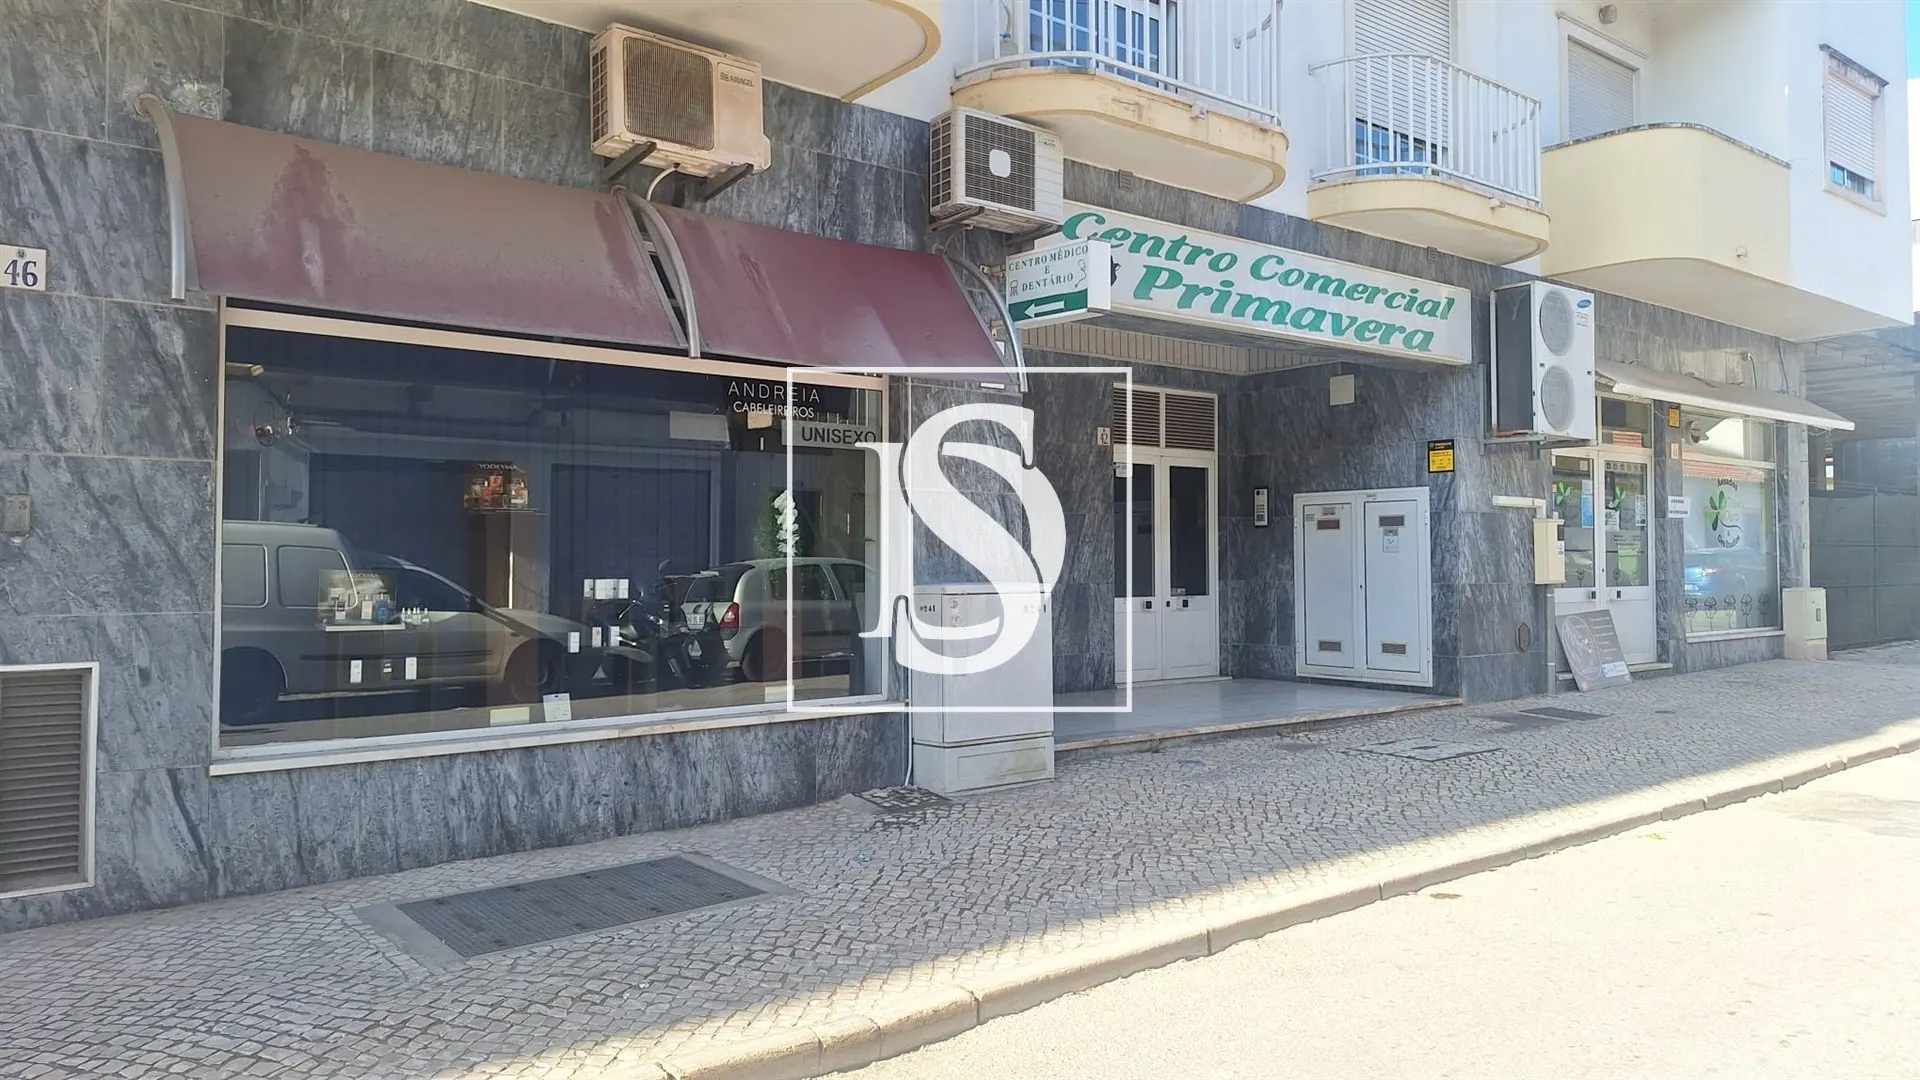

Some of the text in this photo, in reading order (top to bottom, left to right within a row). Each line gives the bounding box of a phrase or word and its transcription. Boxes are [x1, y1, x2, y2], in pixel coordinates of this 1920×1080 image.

[1008, 245, 1088, 272] CENTRO MÉDICO
[1062, 212, 1455, 320] Centro Comercial
[4, 259, 38, 287] 46
[1044, 265, 1051, 275] E
[1022, 272, 1074, 292] DENTÁRIO
[1133, 264, 1435, 352] Primavera
[728, 381, 820, 403] ANDREIA
[733, 401, 815, 419] CABELEIREROS
[802, 426, 877, 445] UNISEXO
